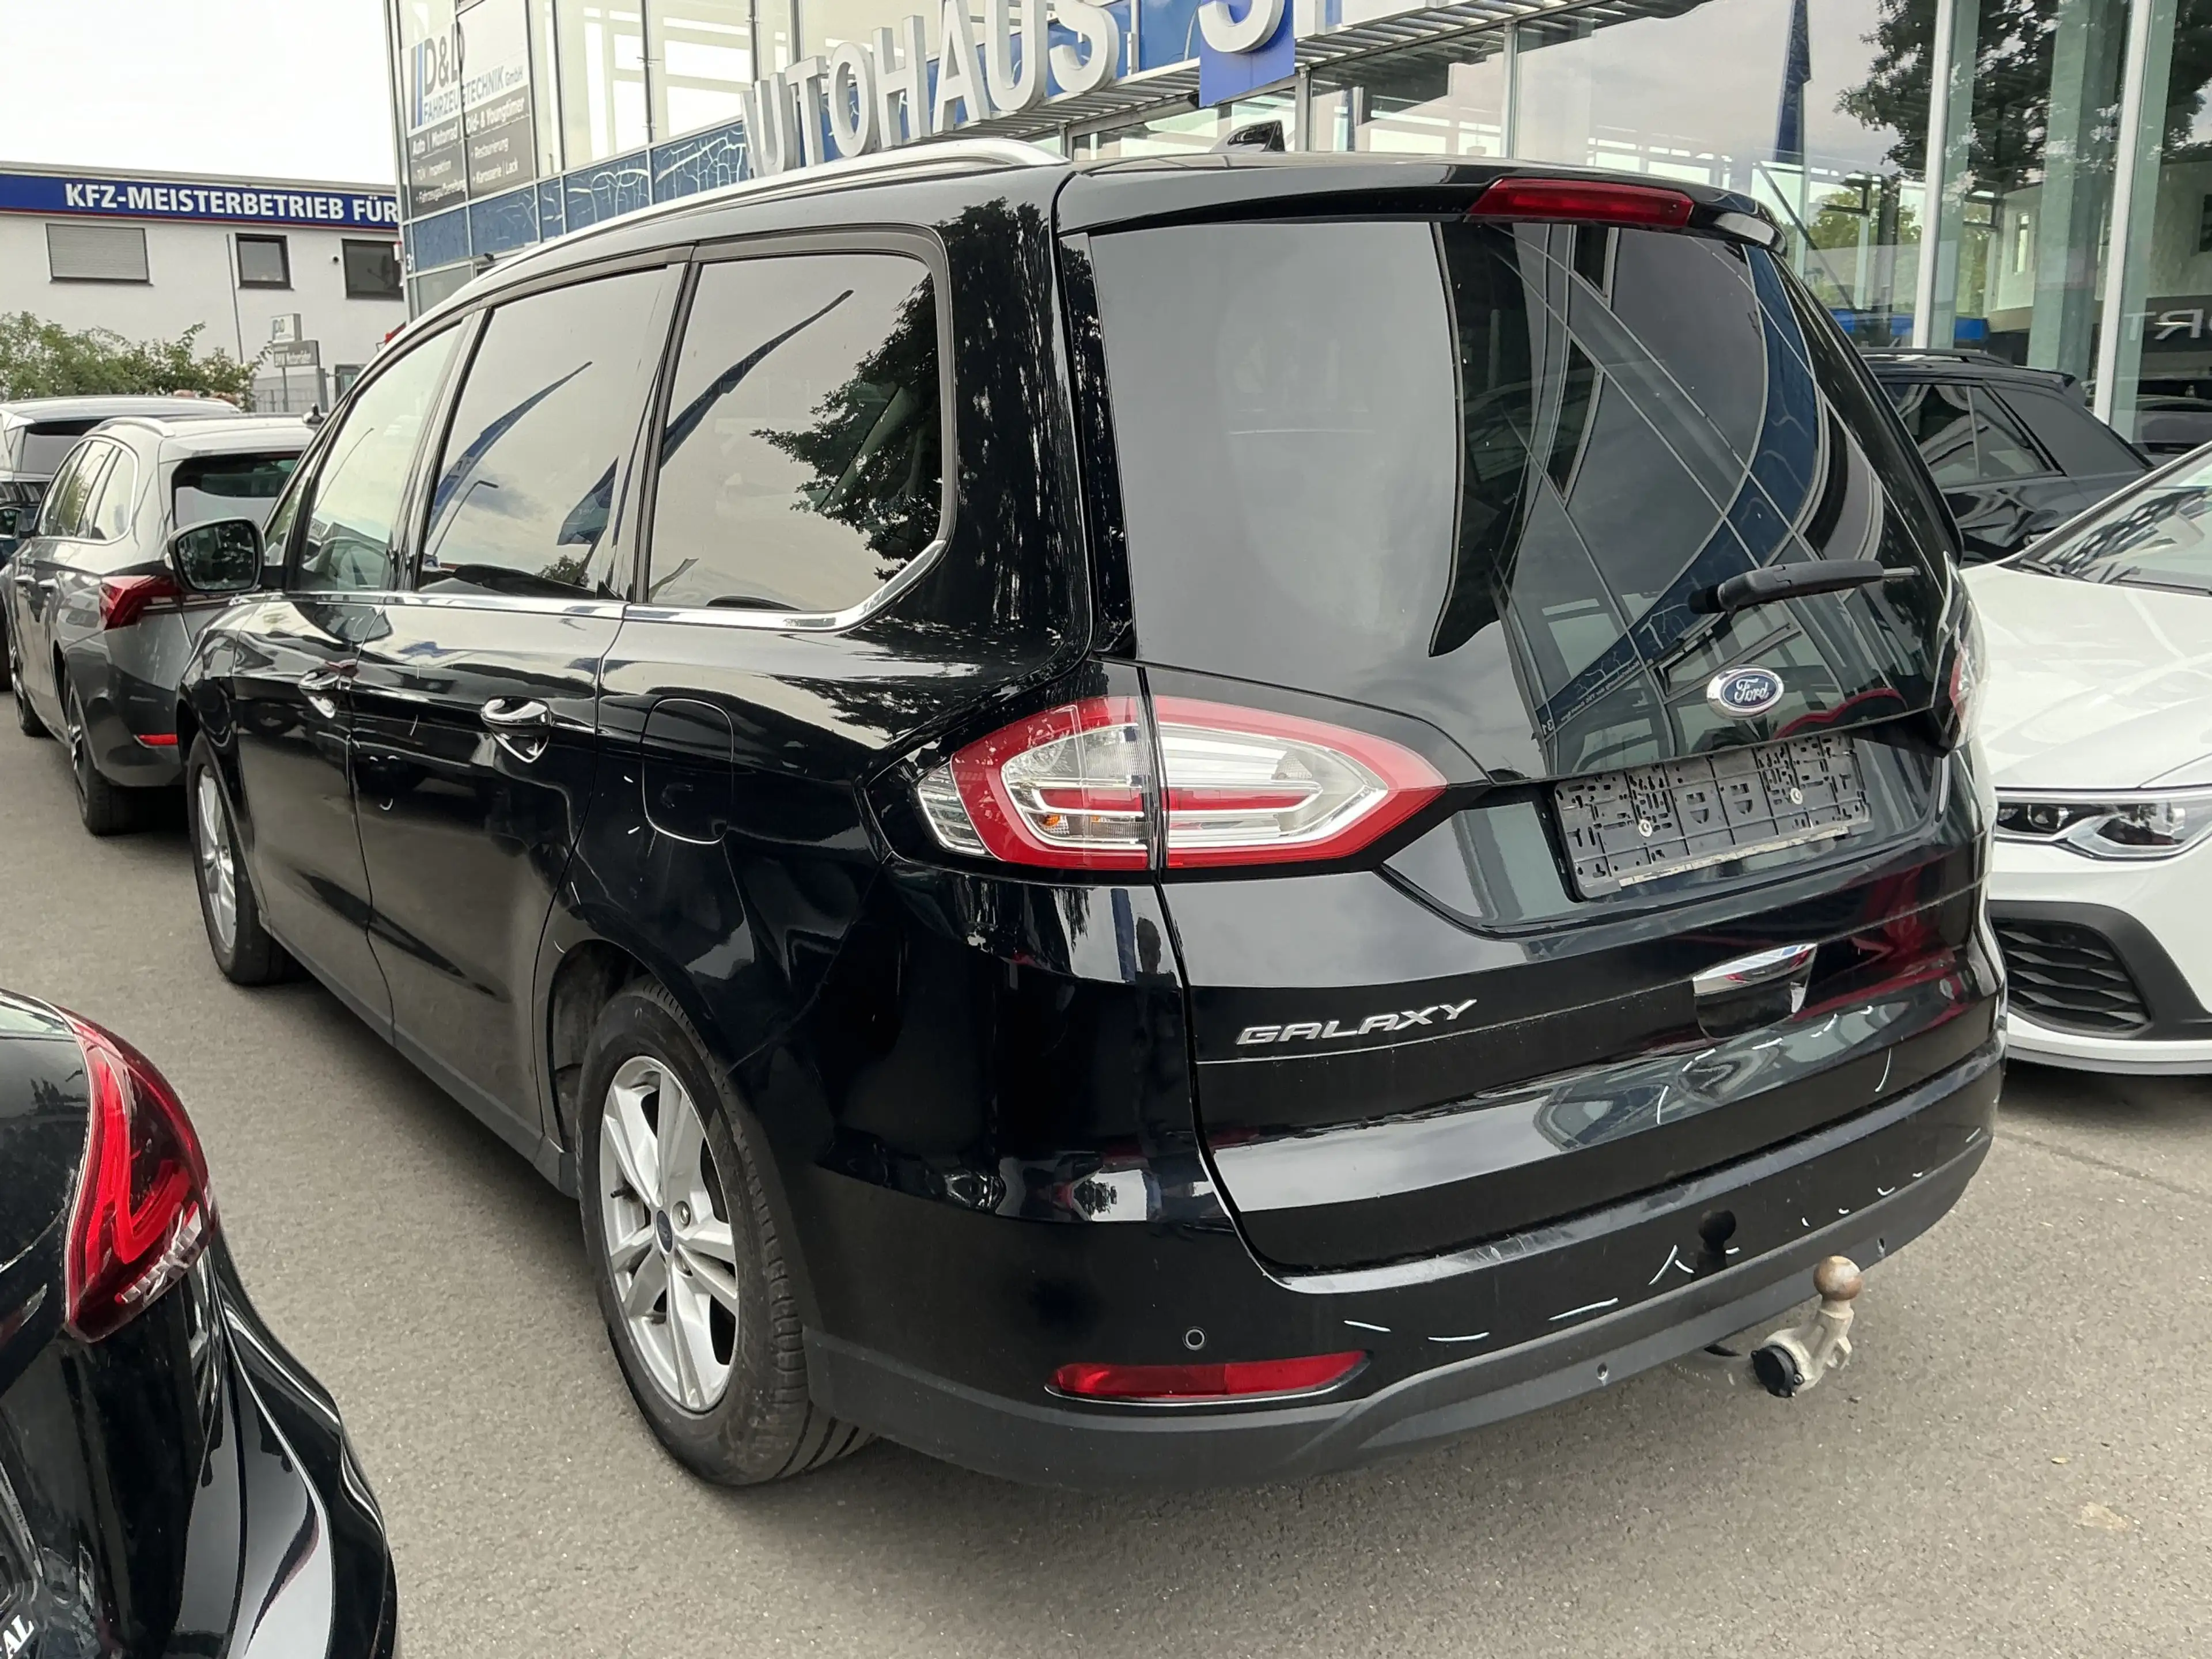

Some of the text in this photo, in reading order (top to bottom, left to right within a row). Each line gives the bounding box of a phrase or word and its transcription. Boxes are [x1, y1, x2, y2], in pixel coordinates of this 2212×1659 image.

[424, 22, 465, 97] D&D
[505, 65, 524, 86] GmbH
[65, 183, 399, 223] KFZ-MEISTERBETRIEB FÜR
[1734, 677, 1770, 703] Ford
[1236, 998, 1478, 1046] GALAXY
[0, 1615, 35, 1659] AL
